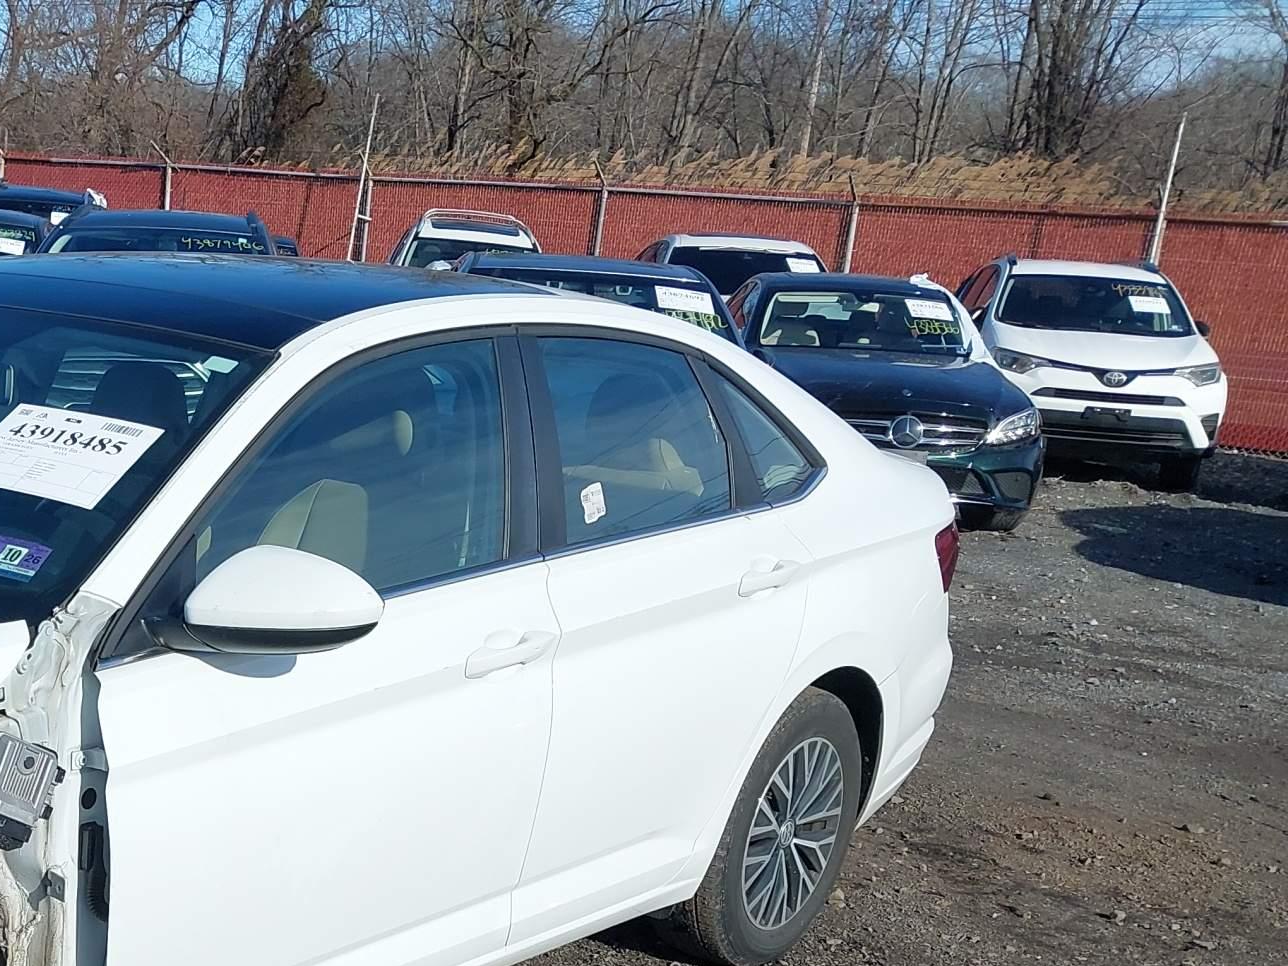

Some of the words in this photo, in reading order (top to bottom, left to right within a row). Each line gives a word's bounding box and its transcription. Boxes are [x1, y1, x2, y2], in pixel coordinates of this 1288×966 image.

[9, 422, 129, 456] 43918485
[1, 547, 22, 563] 10
[23, 554, 42, 565] 26
